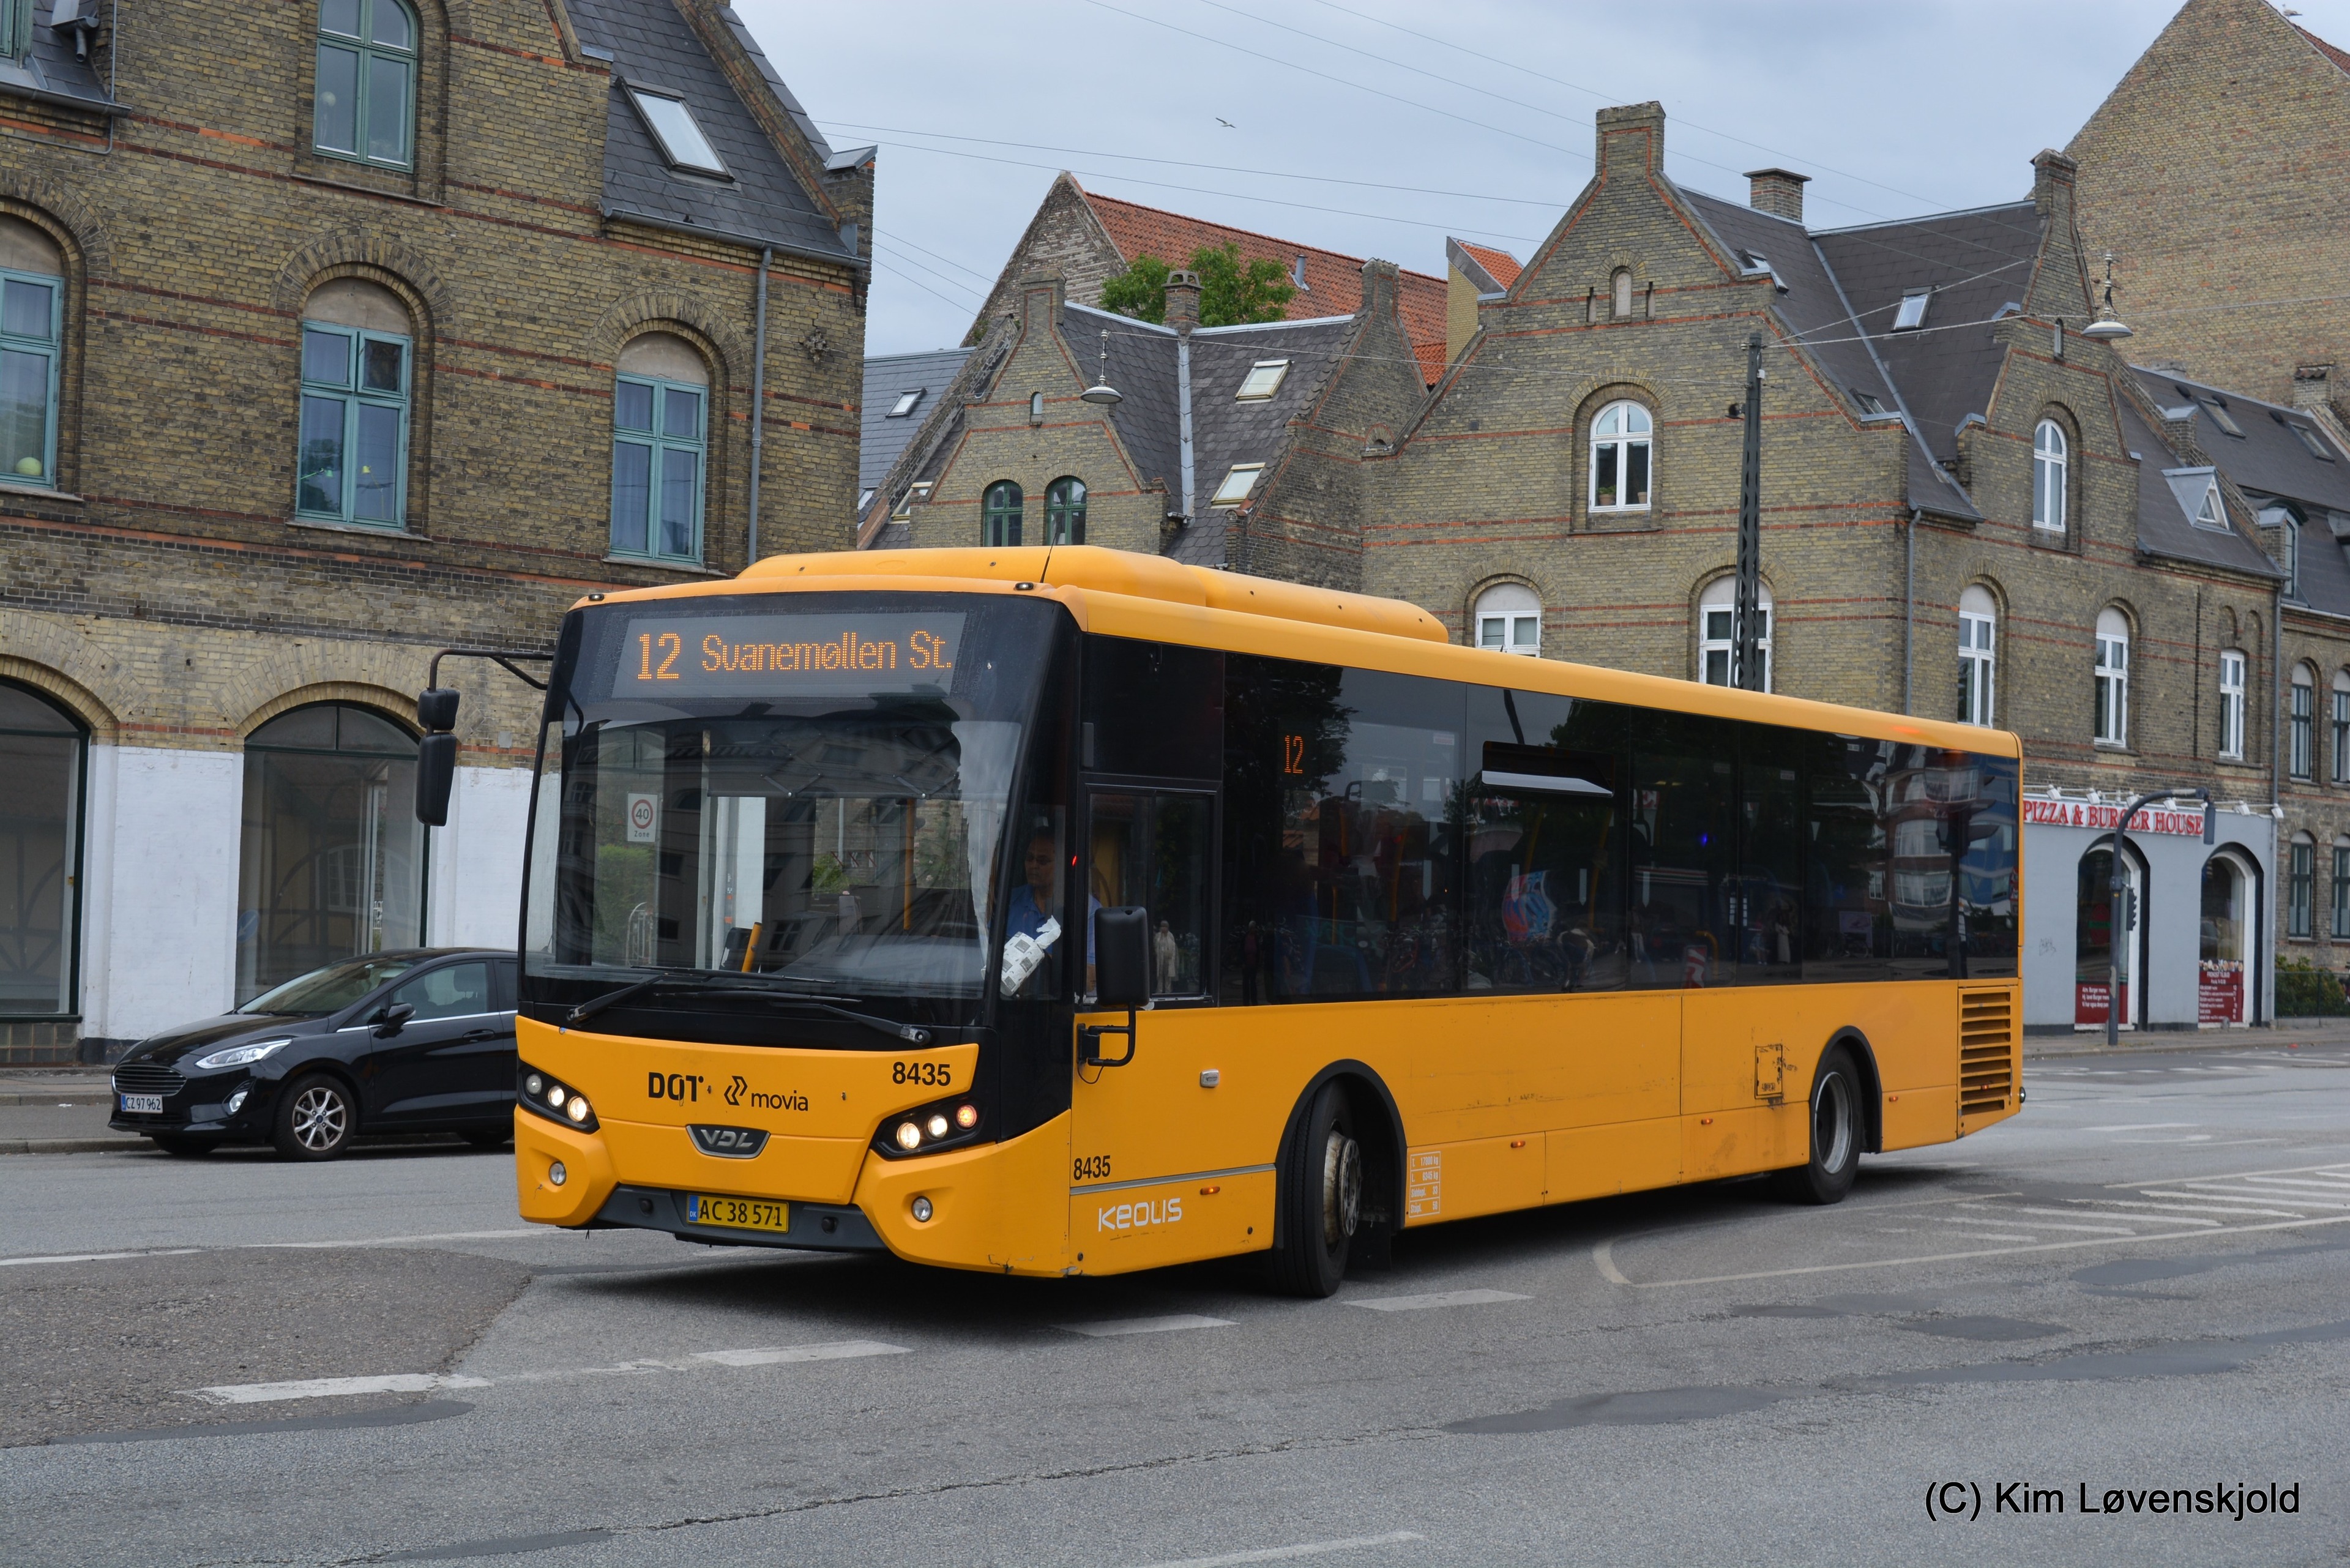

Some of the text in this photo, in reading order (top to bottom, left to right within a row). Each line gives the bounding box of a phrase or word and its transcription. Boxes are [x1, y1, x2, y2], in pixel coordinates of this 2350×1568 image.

[638, 633, 681, 679] 12
[909, 630, 952, 668] St.
[1285, 735, 1303, 774] 12
[636, 808, 649, 819] 40
[2023, 800, 2068, 824] PIZZA
[2073, 804, 2084, 825] &
[2154, 812, 2203, 834] HOUSE
[892, 1061, 951, 1087] 8435
[648, 1072, 704, 1103] DOT
[751, 1090, 808, 1111] movia
[126, 1097, 161, 1110] CZ 97 962
[700, 1129, 753, 1148] VDL
[1073, 1155, 1111, 1181] 8435
[1433, 1155, 1439, 1165] kg
[1433, 1170, 1438, 1181] kg
[699, 1200, 782, 1226] AC 38 571
